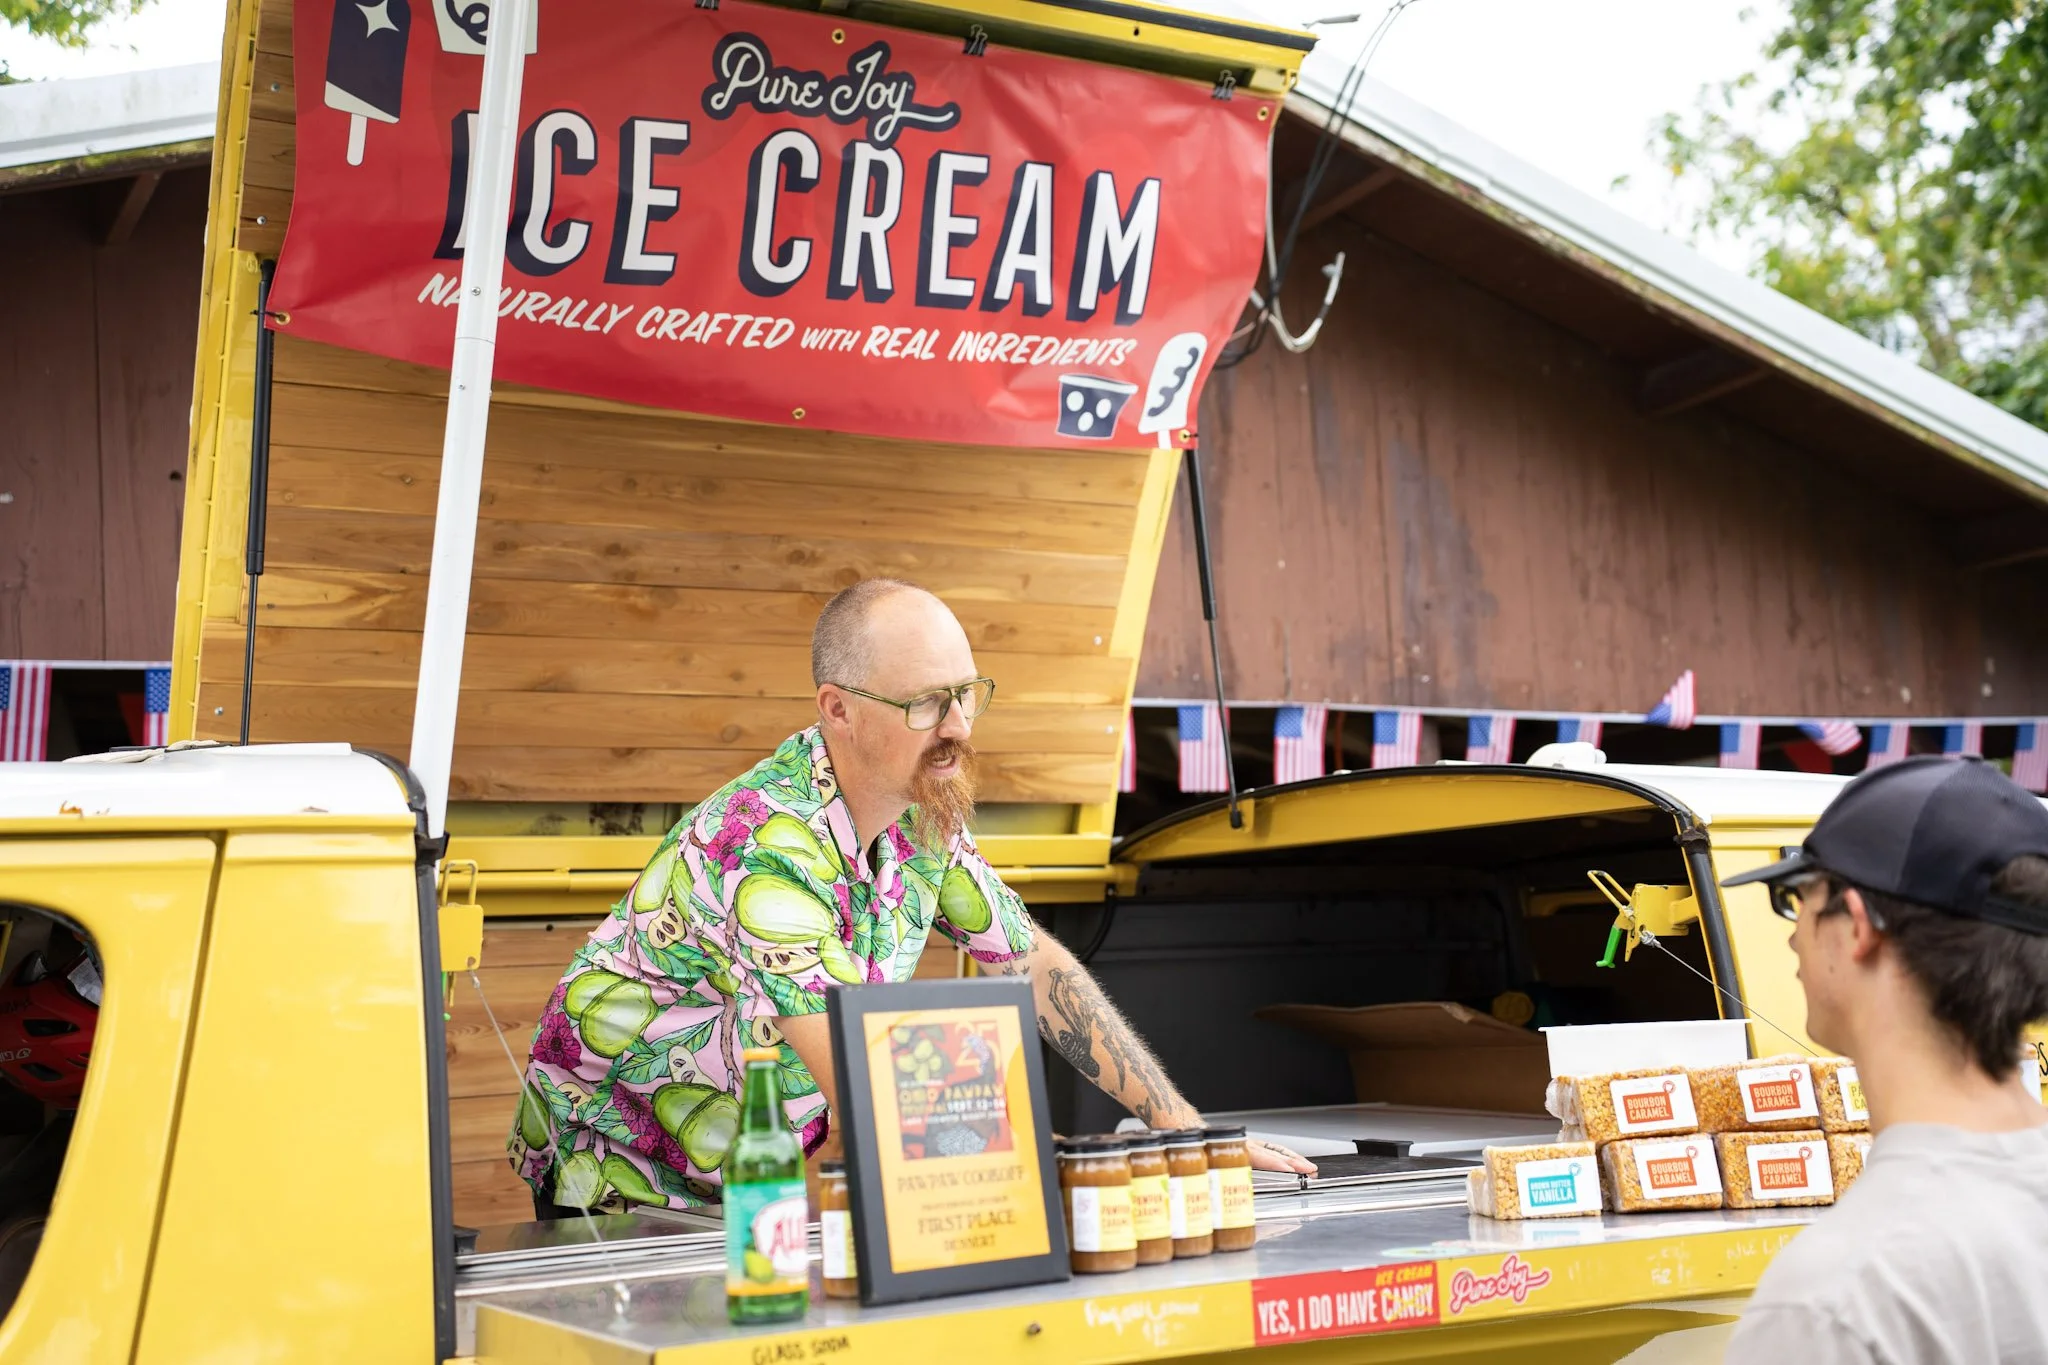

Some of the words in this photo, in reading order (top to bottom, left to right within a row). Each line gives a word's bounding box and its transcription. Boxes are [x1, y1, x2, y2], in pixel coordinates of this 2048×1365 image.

[710, 41, 823, 112] Pure
[830, 51, 954, 142] Joy
[433, 109, 691, 286] ICE
[739, 129, 1160, 326] CREAM
[417, 272, 634, 335] NAURALLY
[636, 305, 796, 350] CRAFTED
[801, 326, 862, 354] WITH
[862, 325, 936, 361] REAL
[948, 330, 1138, 367] INGREDIENTS
[1753, 1084, 1793, 1099] BOURBON
[1627, 1095, 1667, 1109] BOURBON
[1756, 1097, 1797, 1109] CARAMEL
[1629, 1107, 1670, 1121] CARAMEL
[1651, 1161, 1690, 1175] BOURBON
[1761, 1161, 1802, 1175] BOURBON
[1653, 1173, 1693, 1186] CARAMEL
[1763, 1173, 1804, 1186] CARAMEL
[1531, 1187, 1574, 1204] VANILLA
[918, 1213, 966, 1236] FIRST
[967, 1208, 1017, 1230] PLACE
[1375, 1270, 1394, 1287] ICE
[1396, 1265, 1434, 1283] CREAM
[1450, 1268, 1497, 1315] Pure
[1496, 1255, 1550, 1303] Joy
[1257, 1299, 1297, 1337] YES,
[1298, 1297, 1306, 1331] I
[1308, 1294, 1333, 1329] DO
[1336, 1289, 1378, 1326] HAVE
[1380, 1283, 1435, 1322] CANDY
[752, 1341, 805, 1365] GLASS
